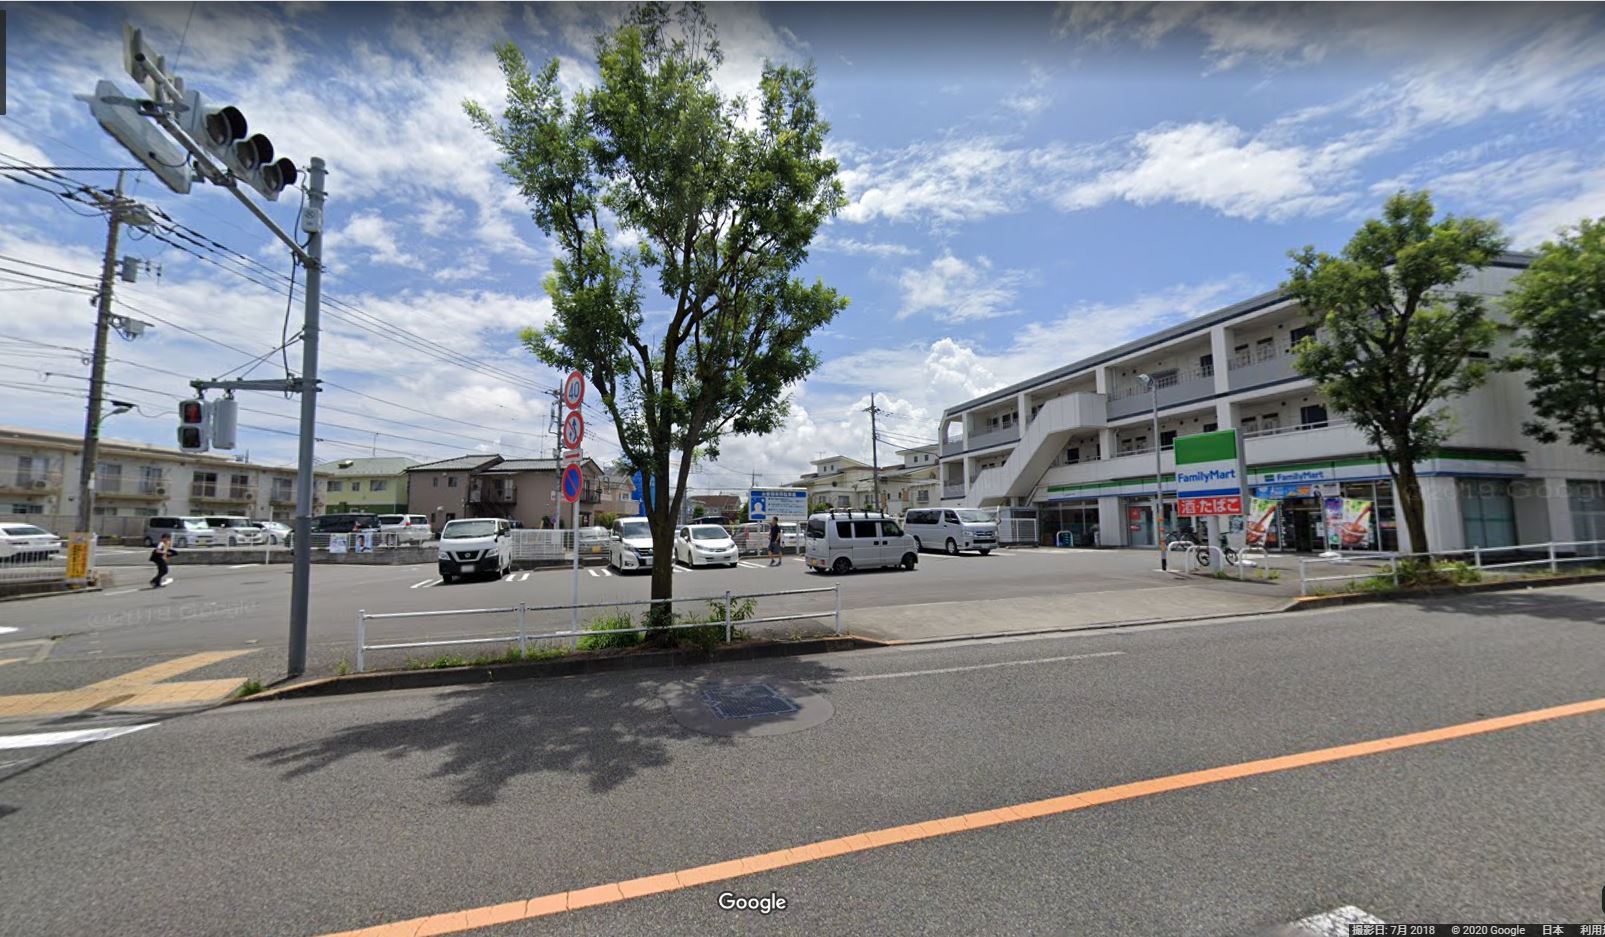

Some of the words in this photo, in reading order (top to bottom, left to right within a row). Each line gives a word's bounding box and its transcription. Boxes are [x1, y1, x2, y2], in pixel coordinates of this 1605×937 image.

[569, 381, 580, 399] 40
[1178, 469, 1236, 482] FamilyMart
[1277, 471, 1324, 481] FamilyMart
